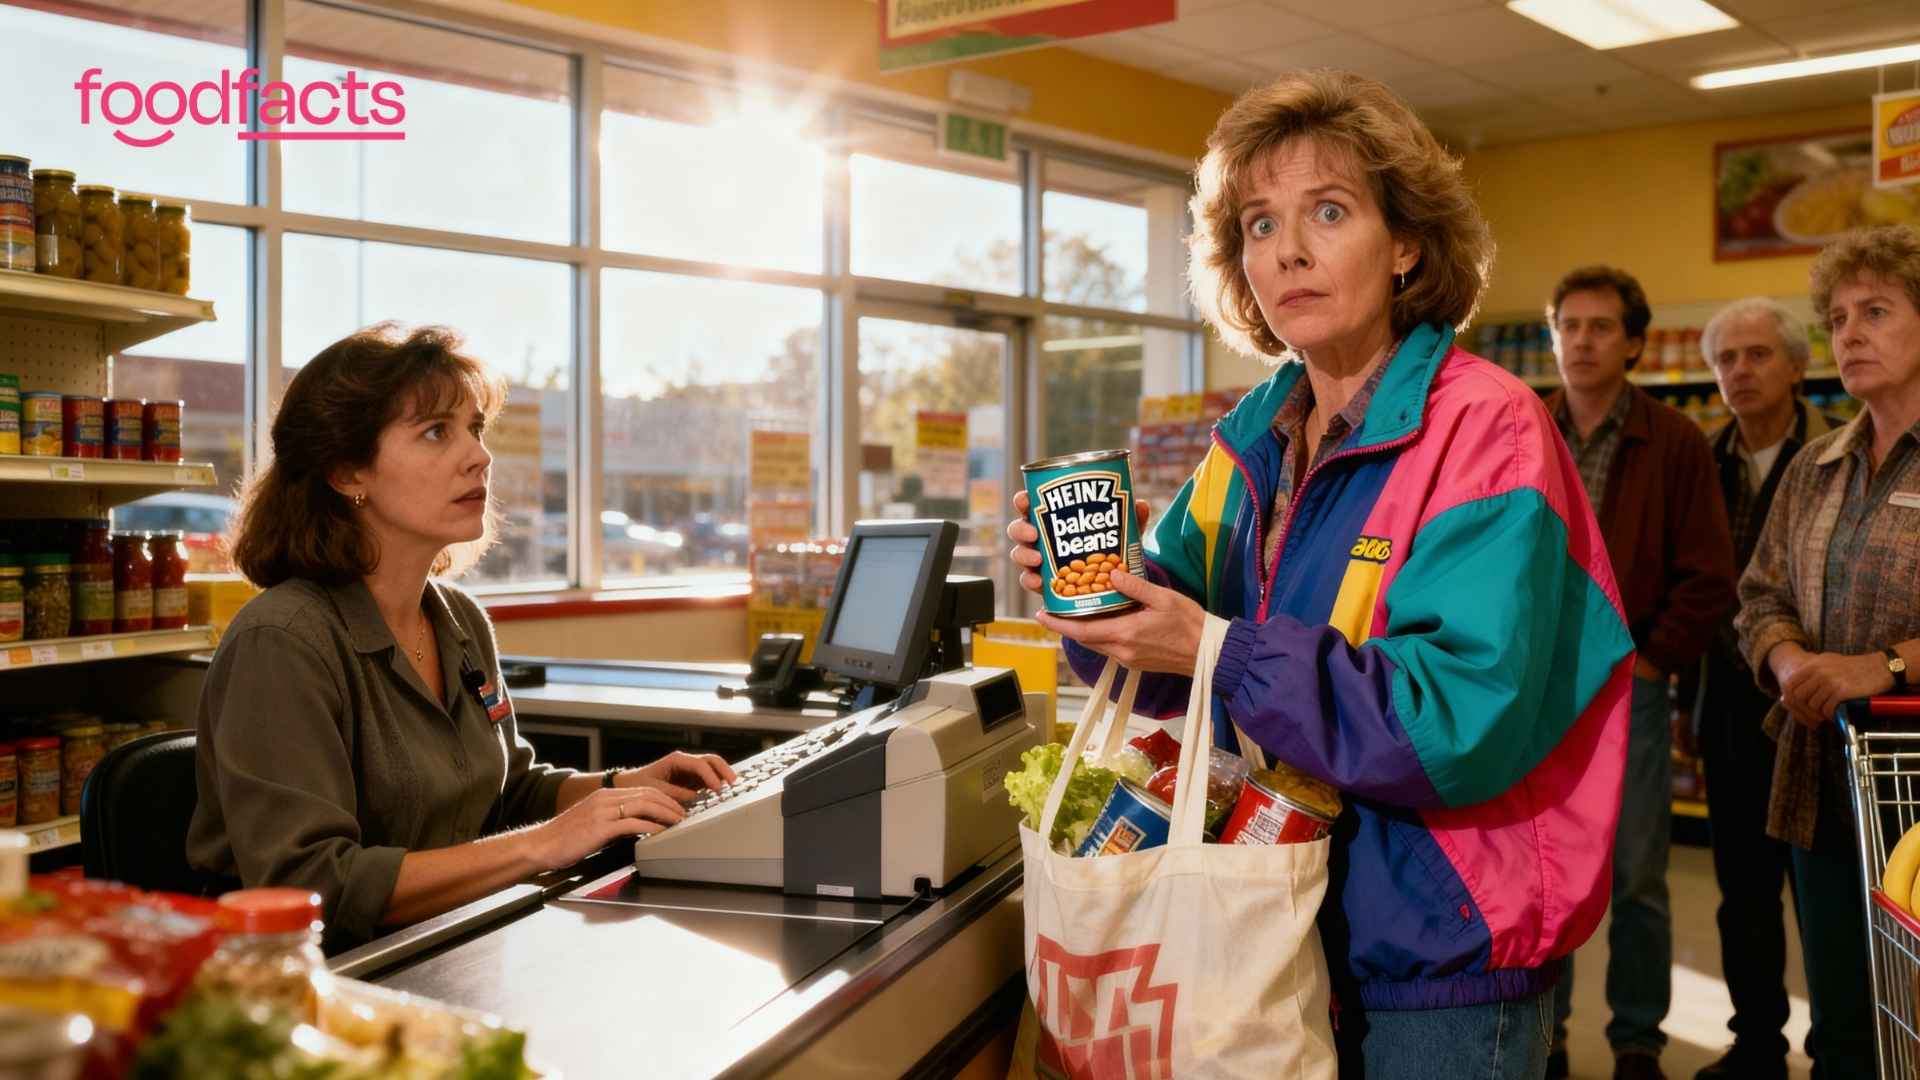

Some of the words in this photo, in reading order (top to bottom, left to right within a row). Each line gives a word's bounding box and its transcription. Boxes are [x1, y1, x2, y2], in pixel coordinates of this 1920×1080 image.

[1045, 481, 1111, 511] HEINZ
[1050, 502, 1119, 537] baked
[1057, 529, 1118, 557] beans
